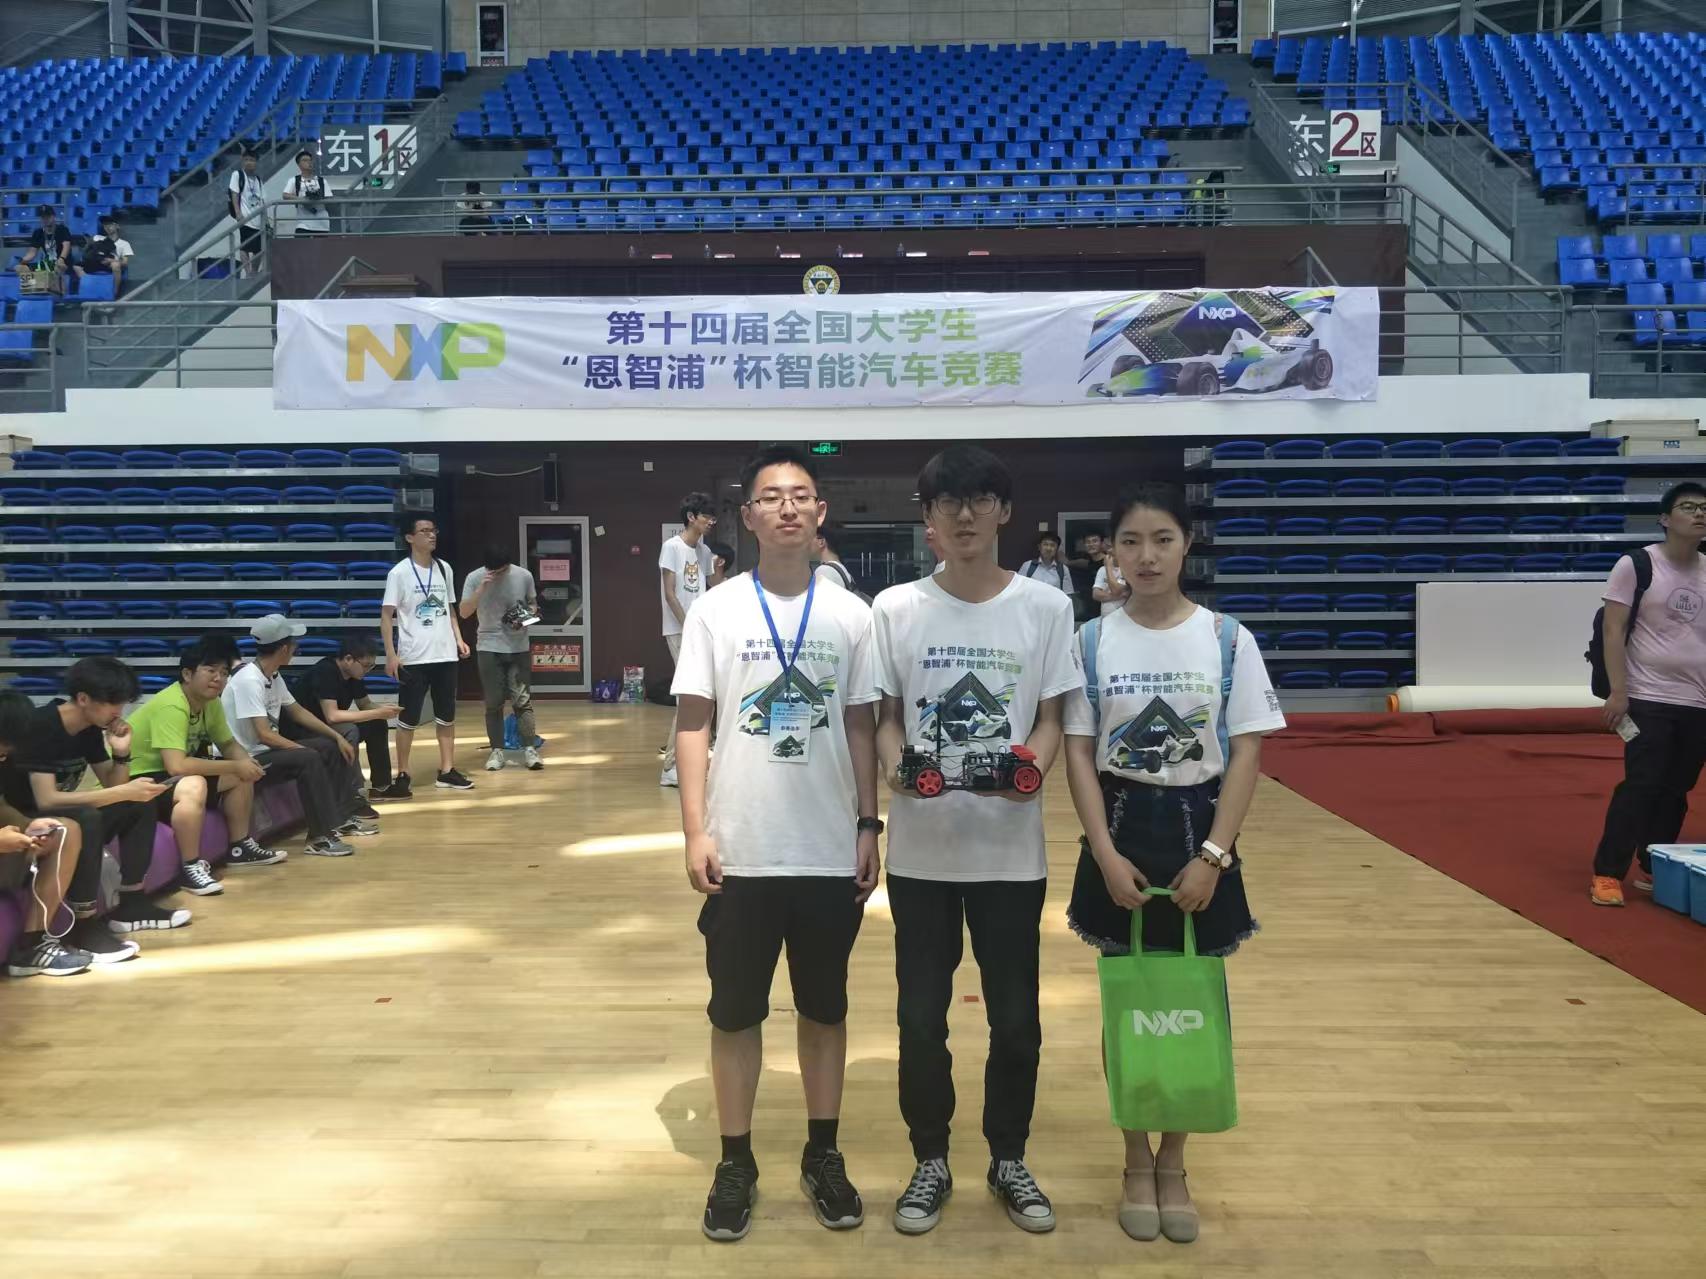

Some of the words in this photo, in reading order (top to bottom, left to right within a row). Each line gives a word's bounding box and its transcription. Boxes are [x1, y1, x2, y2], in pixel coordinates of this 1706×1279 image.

[606, 308, 978, 345] 第十四届全国大学生
[1198, 306, 1237, 320] NXP
[346, 322, 506, 381] NXP
[562, 352, 1023, 390] “恩智浦”杯智能汽车竞赛
[1133, 1009, 1204, 1036] NXP
